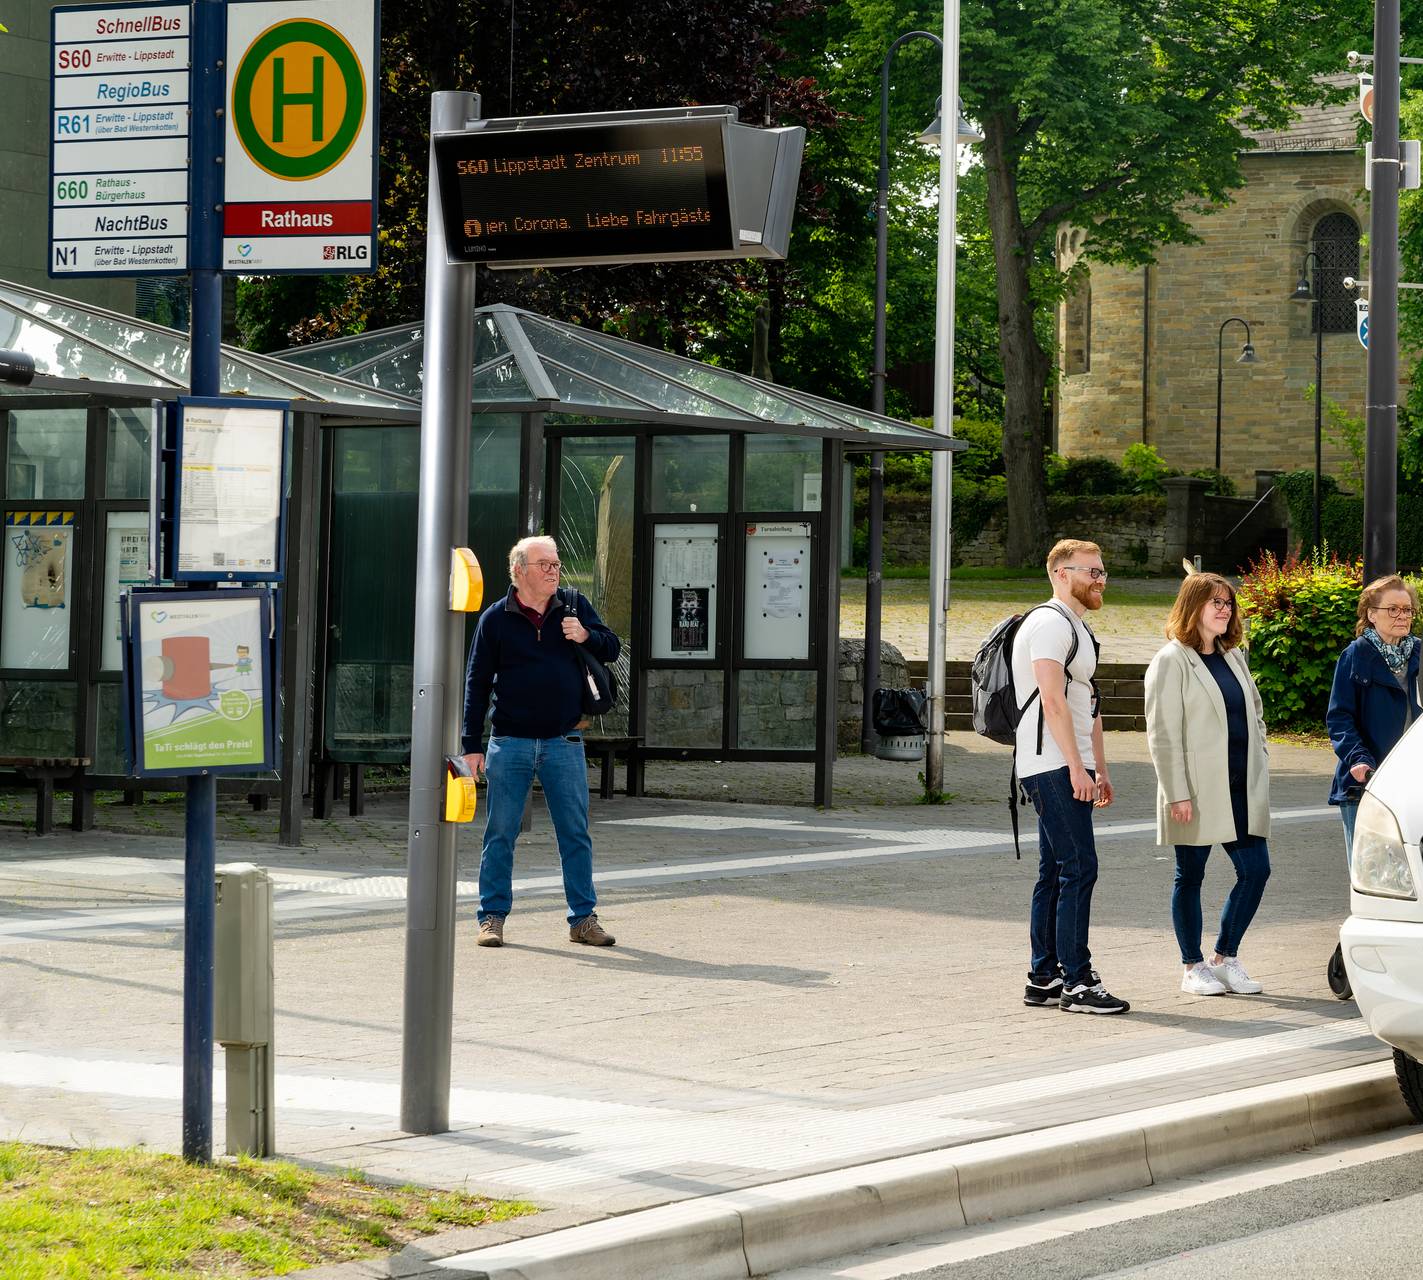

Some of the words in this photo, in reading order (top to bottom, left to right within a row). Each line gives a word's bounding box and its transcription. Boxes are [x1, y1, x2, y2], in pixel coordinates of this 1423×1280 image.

[96, 16, 181, 34] SchnellBus
[58, 49, 91, 69] S60
[96, 53, 126, 62] Erwitte
[134, 50, 175, 62] Lippstadt
[97, 82, 170, 102] RegioBus
[272, 56, 324, 143] H
[58, 114, 90, 134] R61
[96, 114, 125, 123] Erwitte
[133, 112, 174, 122] Lippstadt
[114, 125, 128, 133] Bad
[130, 123, 179, 132] Westernkotten)
[494, 154, 567, 176] Lippstadt
[574, 152, 640, 168] Zentrum
[661, 146, 704, 163] 11:55
[58, 180, 88, 200] 660
[96, 178, 130, 188] Rathaus
[96, 191, 145, 202] Bürgerhaus
[95, 215, 168, 232] NachtBus
[261, 210, 334, 228] Rathaus
[515, 217, 571, 231] Corona.
[586, 212, 629, 228] Liebe
[56, 246, 78, 266] N1
[94, 246, 124, 256] Erwitte
[132, 244, 173, 256] Lippstadt
[94, 258, 111, 267] (über
[113, 258, 127, 266] Bad
[128, 256, 178, 266] Westernkotten)
[336, 245, 368, 260] RLG
[174, 742, 207, 752] schlägt
[208, 742, 224, 750] den
[226, 739, 253, 749] Preis!
